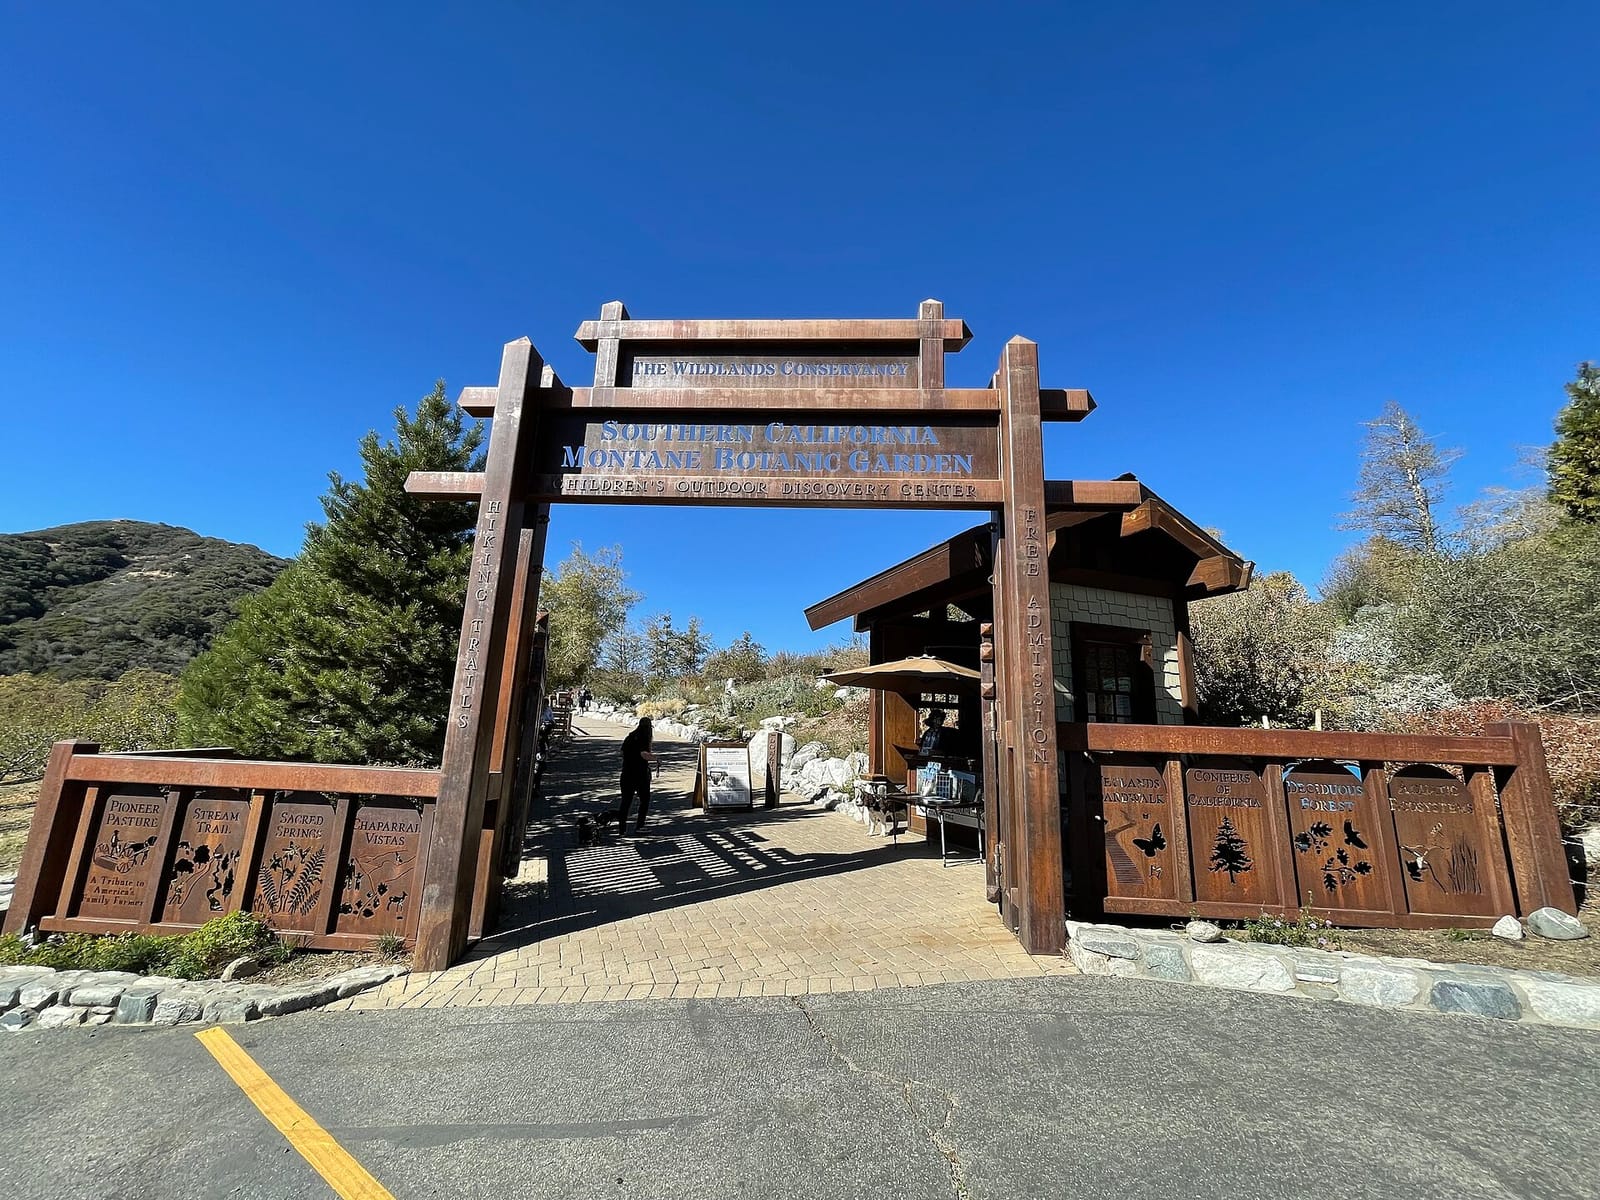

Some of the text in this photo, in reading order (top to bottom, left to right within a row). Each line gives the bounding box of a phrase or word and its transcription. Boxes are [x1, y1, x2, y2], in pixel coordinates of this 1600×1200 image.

[634, 361, 908, 376] THE WILDLANDS CONSERVANCY
[601, 420, 940, 445] SOUTHERN CALIFORNIA
[561, 446, 973, 474] MONTANE BOTANIC GARDEN
[553, 478, 977, 497] CHILDREN'S OUTDOOR DISCOVERY CENTER
[458, 501, 502, 728] HIKING TRAILS
[1025, 509, 1049, 764] FREE ADMISSION
[1194, 770, 1251, 784] CONIFERS
[1216, 784, 1231, 795] OF
[1286, 780, 1364, 795] DECIDUOUS
[110, 800, 160, 813] PIONEER
[1188, 793, 1263, 808] CALIFORNIA
[1300, 797, 1355, 812] FOREST
[106, 813, 158, 827] PASTURE
[193, 807, 240, 821] STREAM
[280, 811, 324, 825] SACRED
[196, 821, 232, 834] TRAIL
[275, 825, 322, 838] SPRINGS
[353, 817, 421, 832] CHAPARRAL
[365, 832, 405, 845] VISTAS
[90, 875, 145, 887] A Tribute to
